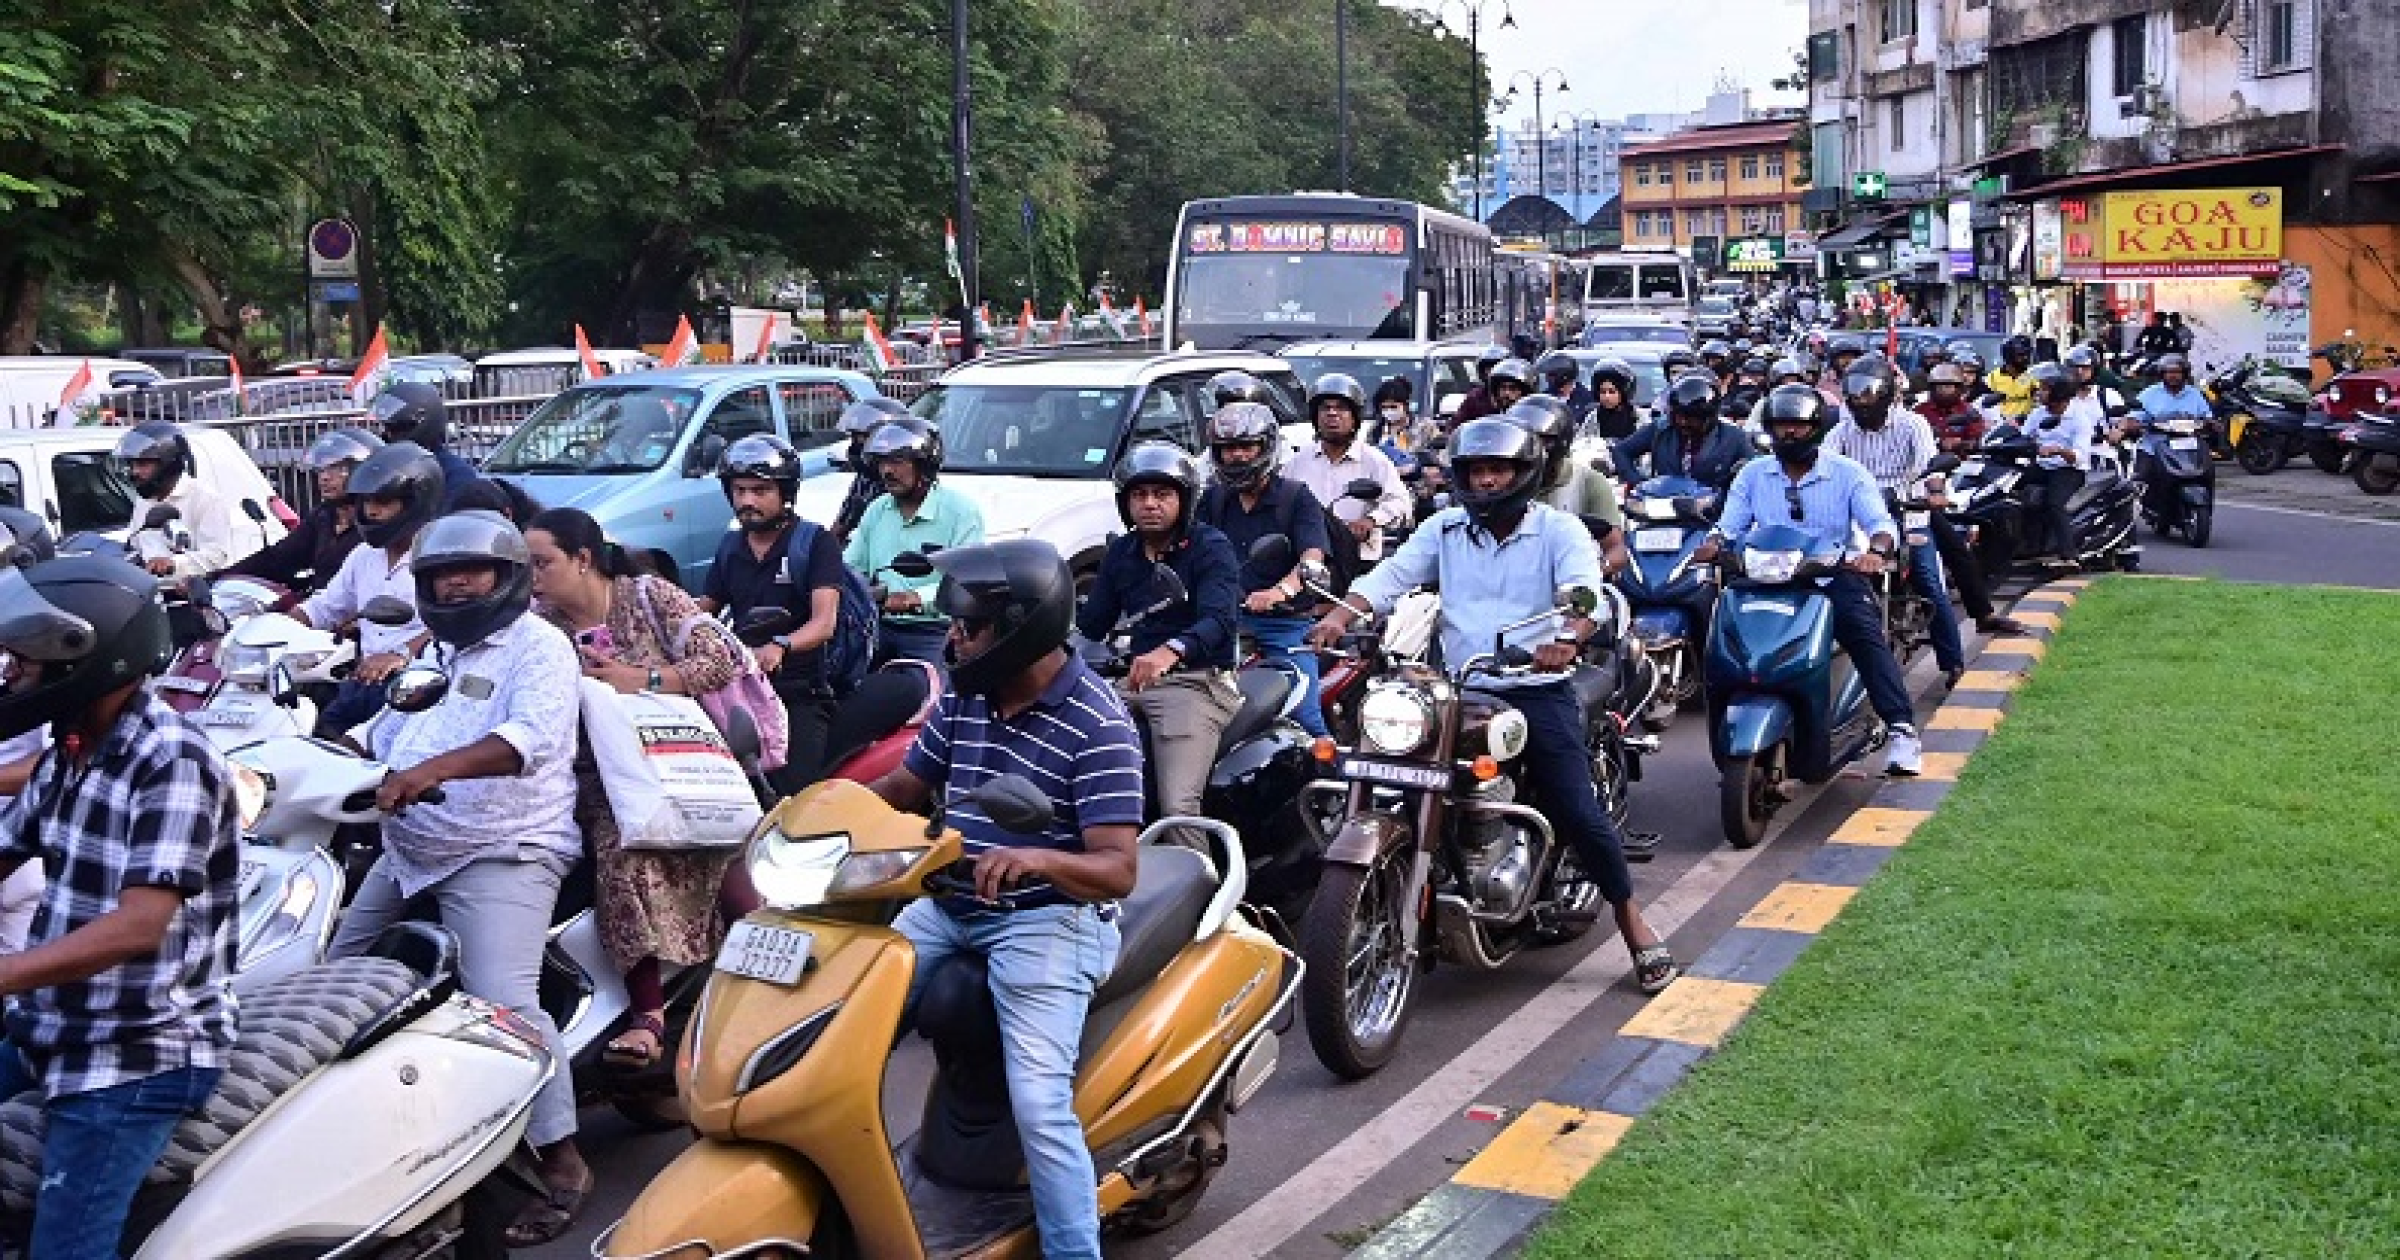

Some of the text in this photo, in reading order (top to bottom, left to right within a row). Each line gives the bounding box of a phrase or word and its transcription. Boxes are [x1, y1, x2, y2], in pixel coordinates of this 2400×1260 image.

[2132, 200, 2240, 226] GOA
[1190, 223, 1226, 254] ST.
[1328, 223, 1405, 255] SAVIO
[2116, 226, 2269, 254] KAJU
